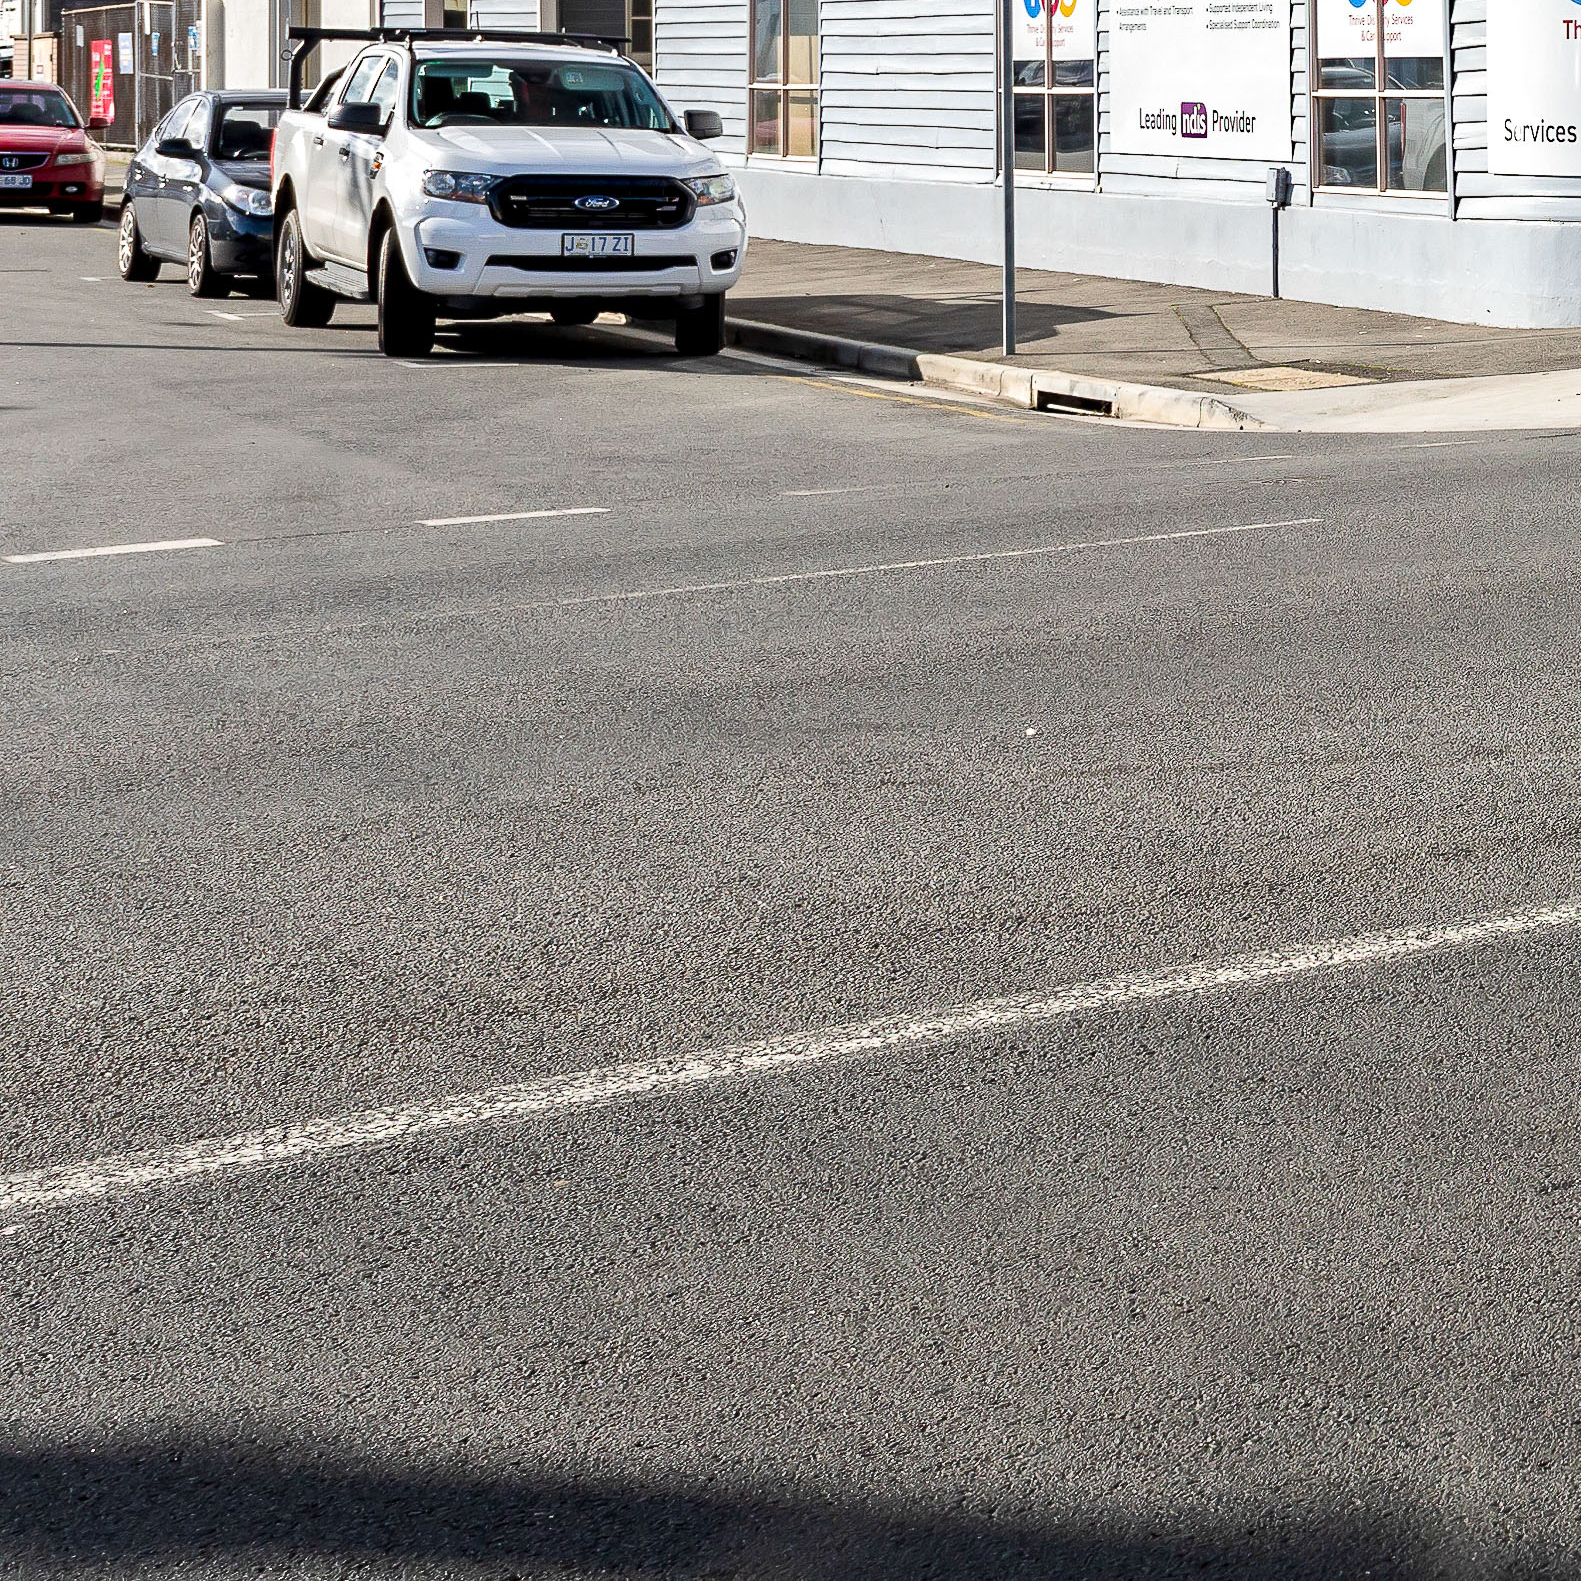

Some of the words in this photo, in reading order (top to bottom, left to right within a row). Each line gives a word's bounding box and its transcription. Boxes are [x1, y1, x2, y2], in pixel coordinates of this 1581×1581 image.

[1139, 108, 1177, 136] Leading
[1182, 104, 1206, 135] ndis
[1212, 110, 1256, 133] Provider
